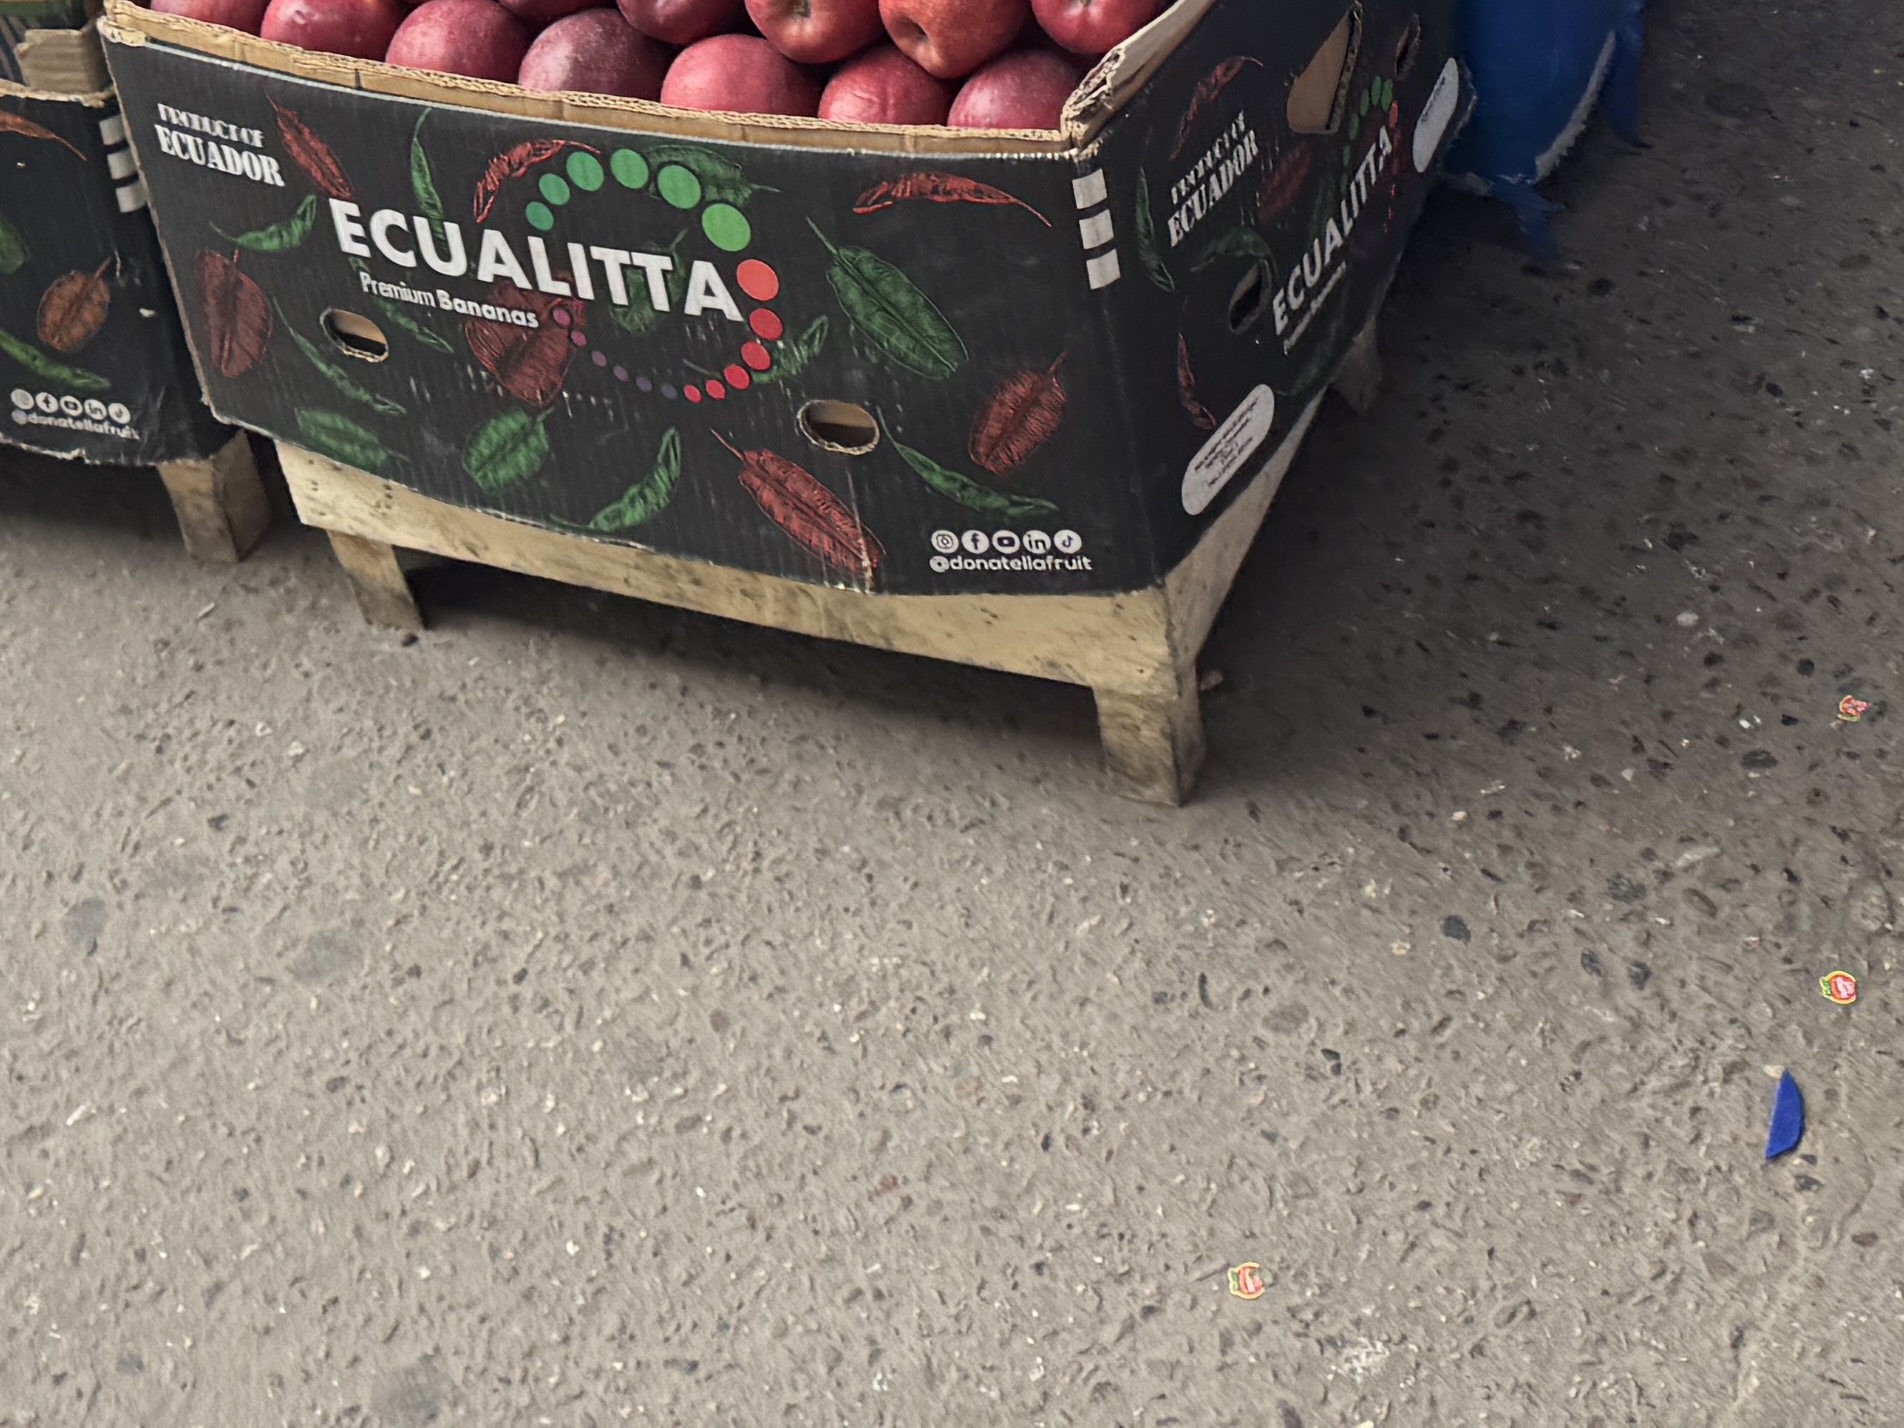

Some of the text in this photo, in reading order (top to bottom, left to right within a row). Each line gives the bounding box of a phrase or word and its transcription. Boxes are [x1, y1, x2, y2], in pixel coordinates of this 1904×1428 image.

[154, 124, 285, 187] ECUADOR
[1168, 130, 1259, 247] ECUADOR
[329, 198, 745, 323] ECUALITTA
[1272, 125, 1392, 336] ECUALITTA
[359, 271, 539, 329] Premium Bananas
[929, 555, 1093, 573] @donatellafruit
